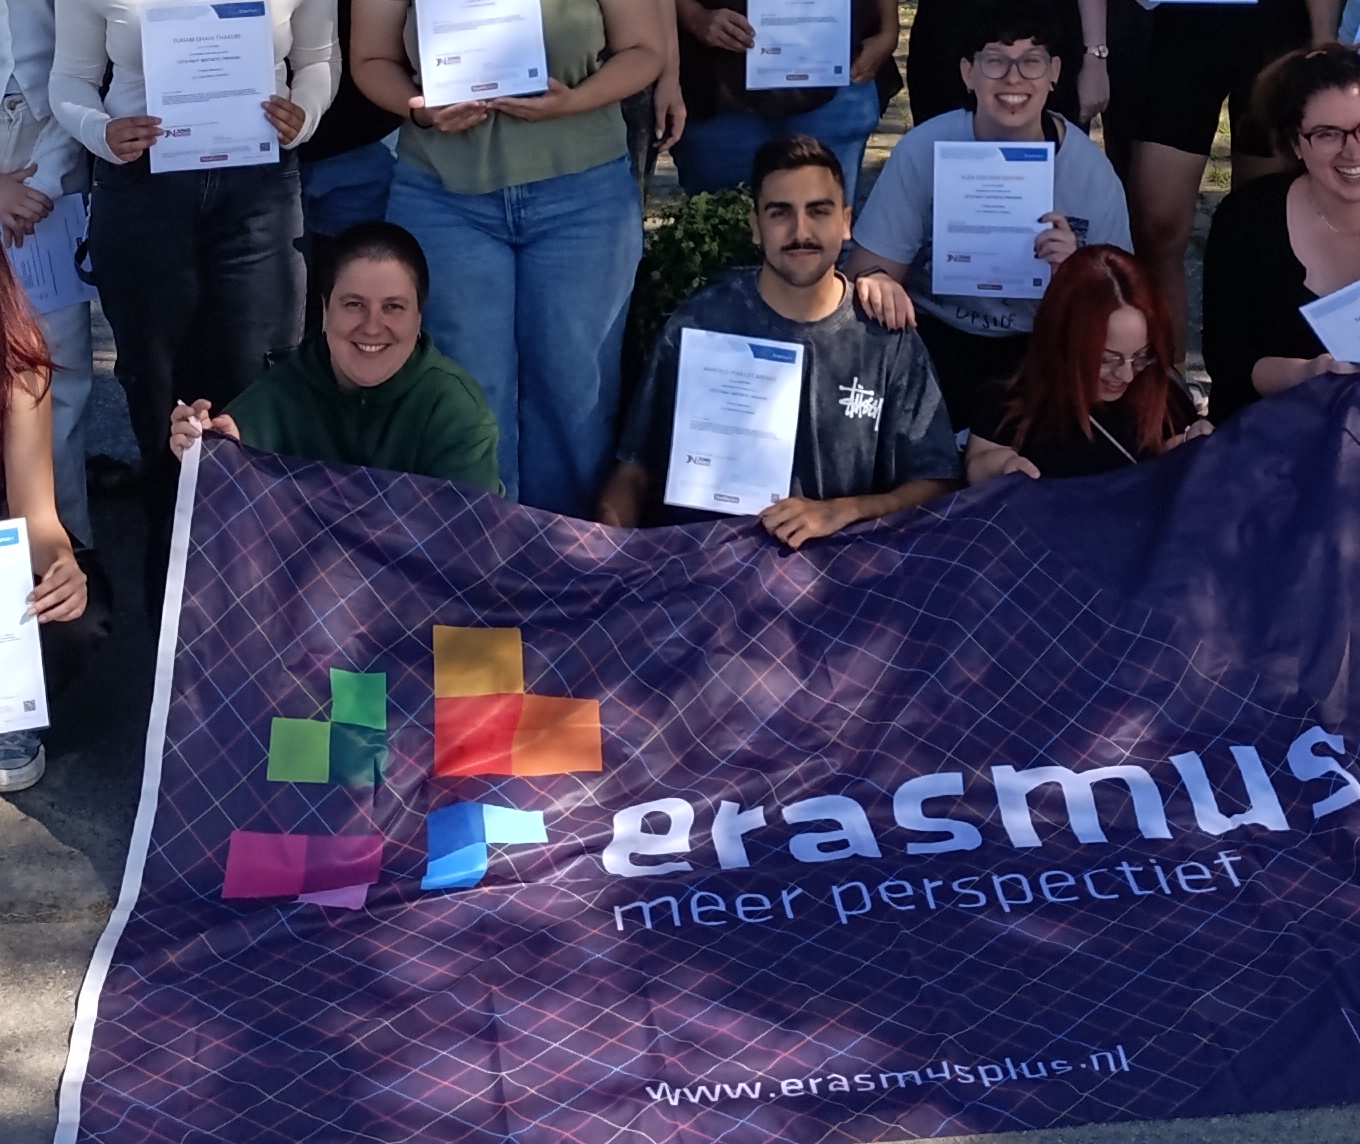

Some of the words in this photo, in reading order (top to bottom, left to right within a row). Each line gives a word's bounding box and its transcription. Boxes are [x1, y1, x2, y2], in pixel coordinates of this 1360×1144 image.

[614, 880, 804, 933] meer
[831, 848, 1244, 926] perspectief
[644, 1044, 1131, 1106] www.erasmusplus.nl
